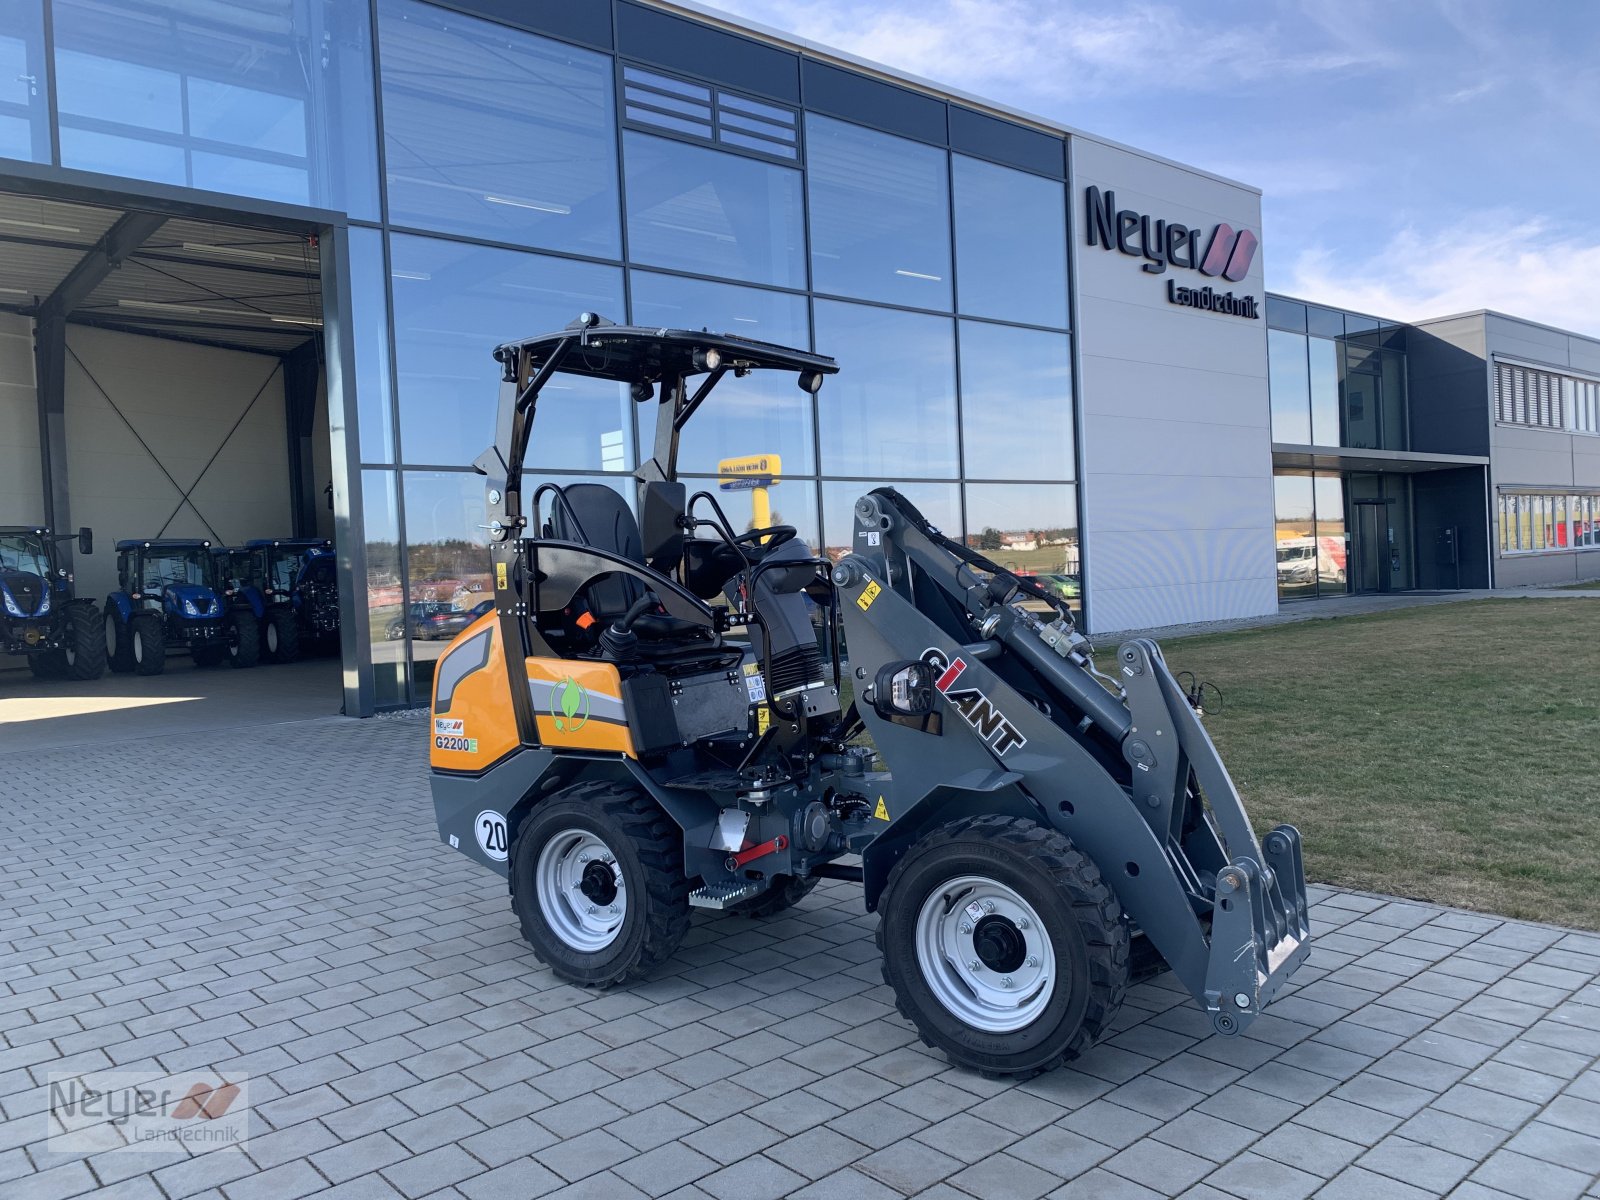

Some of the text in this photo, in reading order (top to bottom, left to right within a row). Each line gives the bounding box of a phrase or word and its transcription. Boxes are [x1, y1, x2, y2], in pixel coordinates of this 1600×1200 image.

[1086, 185, 1201, 274] Neyer
[1168, 279, 1260, 319] Landtechnik
[482, 819, 508, 852] 20
